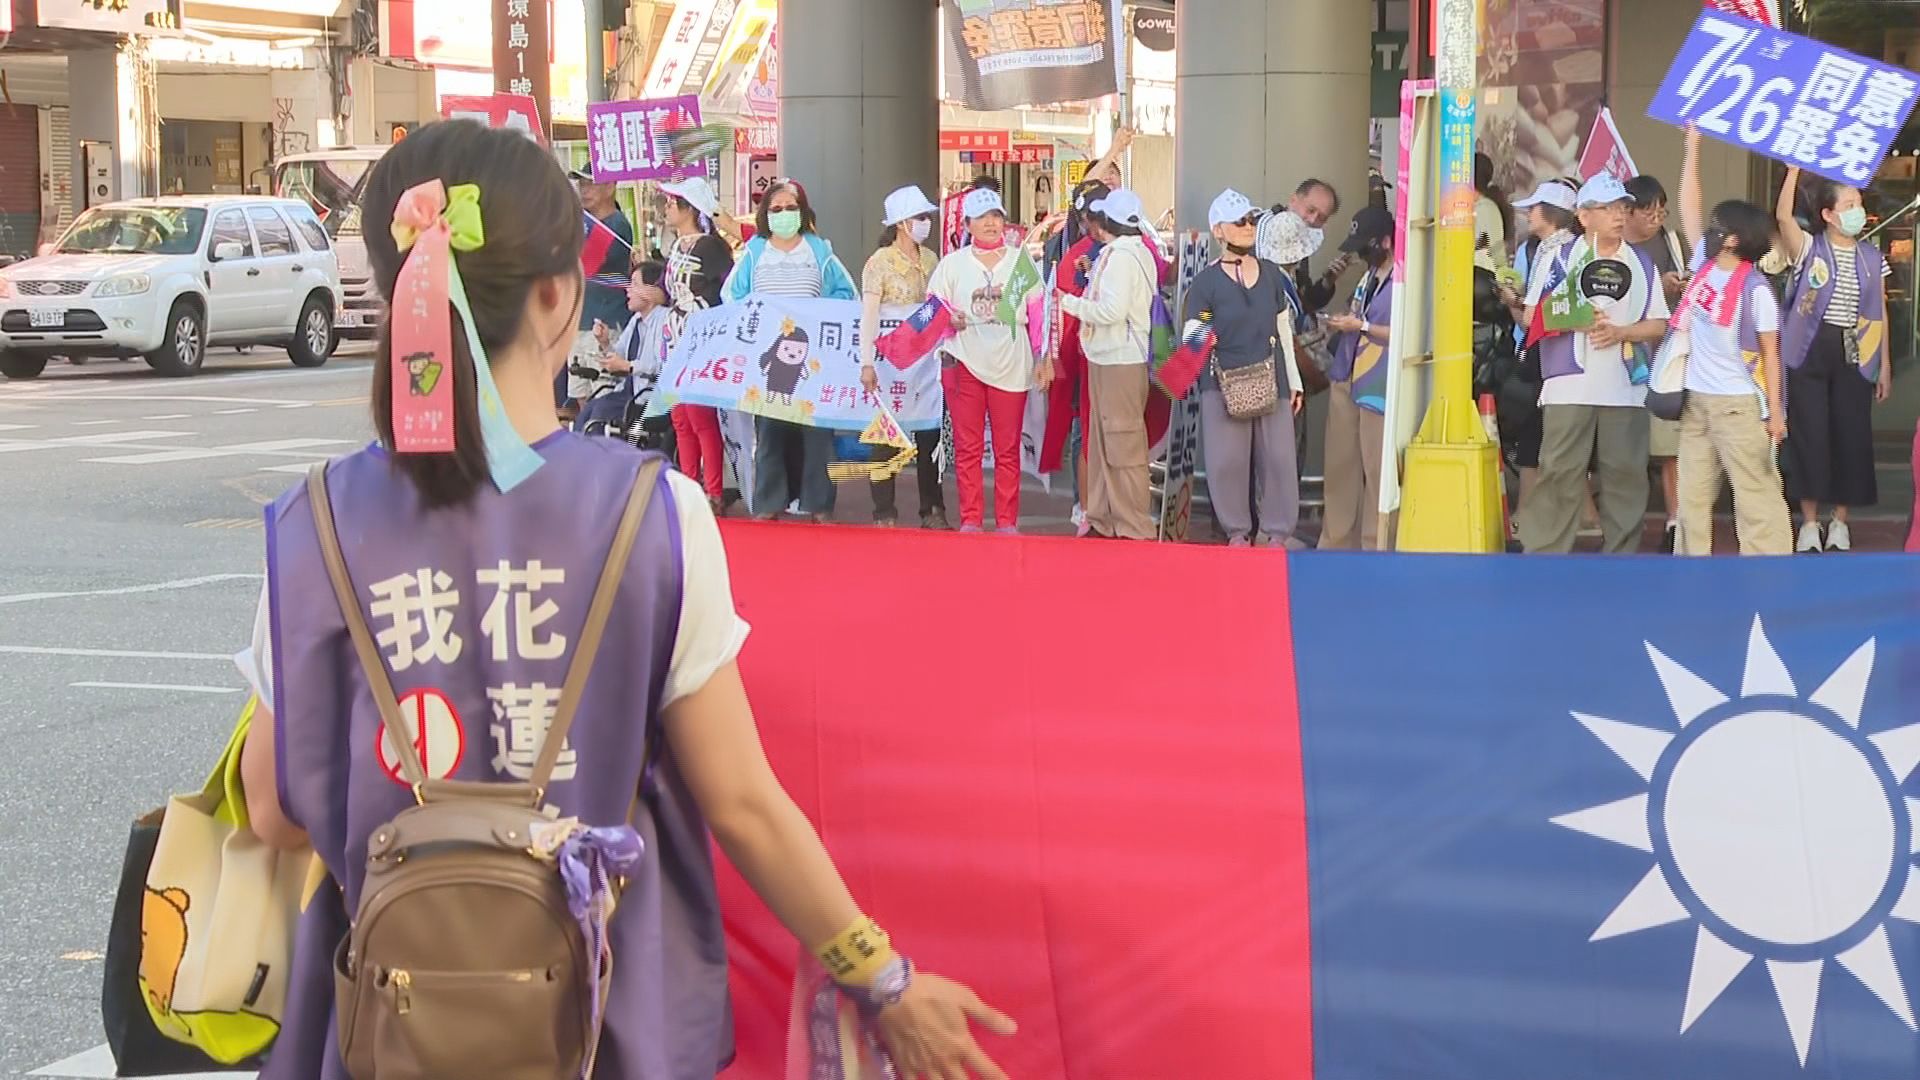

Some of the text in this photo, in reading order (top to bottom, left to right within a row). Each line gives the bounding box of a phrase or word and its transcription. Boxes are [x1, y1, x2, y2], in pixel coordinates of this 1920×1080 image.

[1676, 17, 1797, 144] 7/26
[1799, 51, 1918, 128] 同意
[1770, 103, 1881, 182] 罷免
